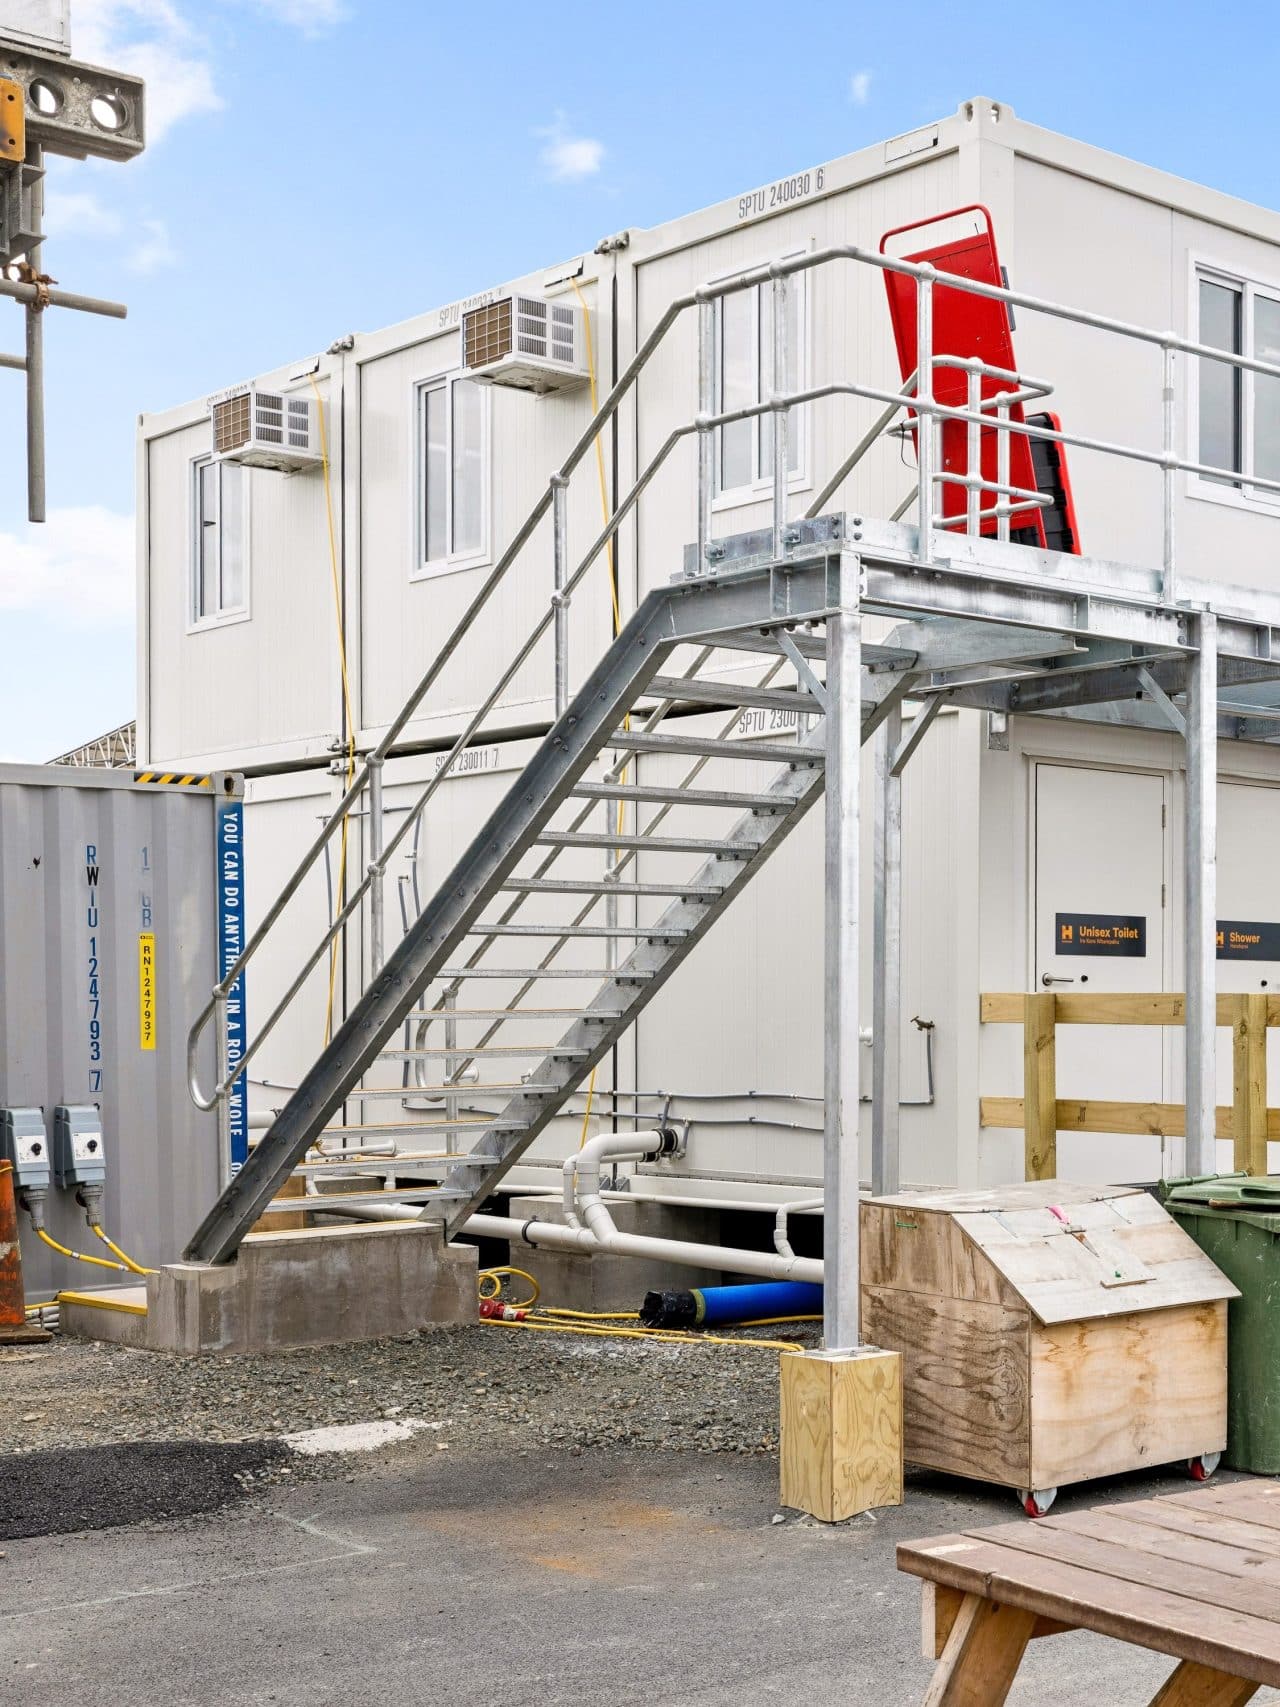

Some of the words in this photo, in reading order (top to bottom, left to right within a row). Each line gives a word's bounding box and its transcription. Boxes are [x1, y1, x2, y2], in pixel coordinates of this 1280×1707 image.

[739, 189, 765, 219] SPTU
[770, 173, 810, 207] 240030
[815, 167, 825, 192] 6
[439, 303, 460, 328] SPTU
[739, 711, 766, 734] SPTU
[458, 748, 488, 771] 230011
[492, 748, 499, 768] 7
[224, 813, 238, 844] YOU
[224, 851, 239, 881] CAN
[224, 887, 239, 907] DO
[1079, 926, 1111, 938] Unisex
[1112, 927, 1139, 939] Toilet
[1229, 931, 1260, 944] Shower
[88, 936, 101, 1061] 124793
[143, 945, 151, 1041] RN1247937
[227, 999, 241, 1014] IN
[227, 1020, 241, 1031] A
[90, 1070, 101, 1091] 7
